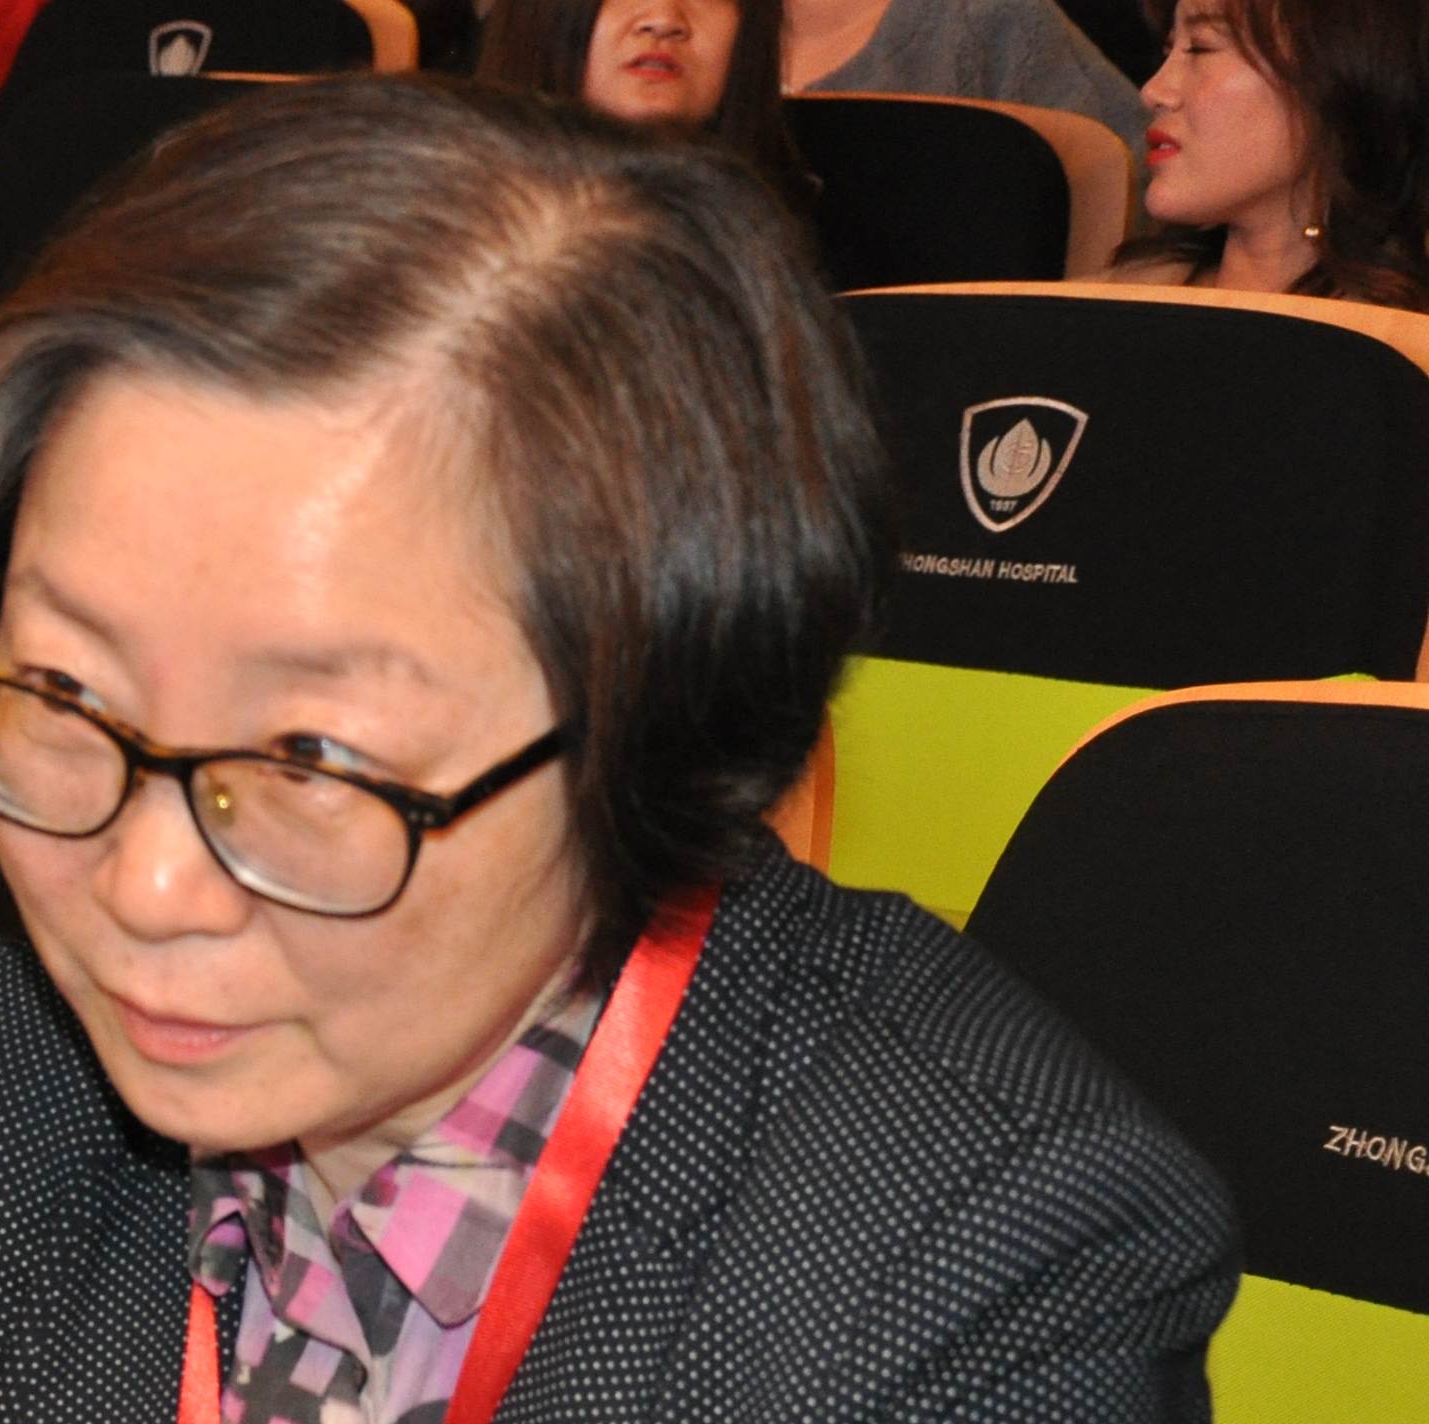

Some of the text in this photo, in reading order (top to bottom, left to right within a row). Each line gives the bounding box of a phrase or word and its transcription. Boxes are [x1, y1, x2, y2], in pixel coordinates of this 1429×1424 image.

[901, 551, 1079, 583] HONGSHAN HOSPITAL
[1323, 1125, 1429, 1177] ZHONG
